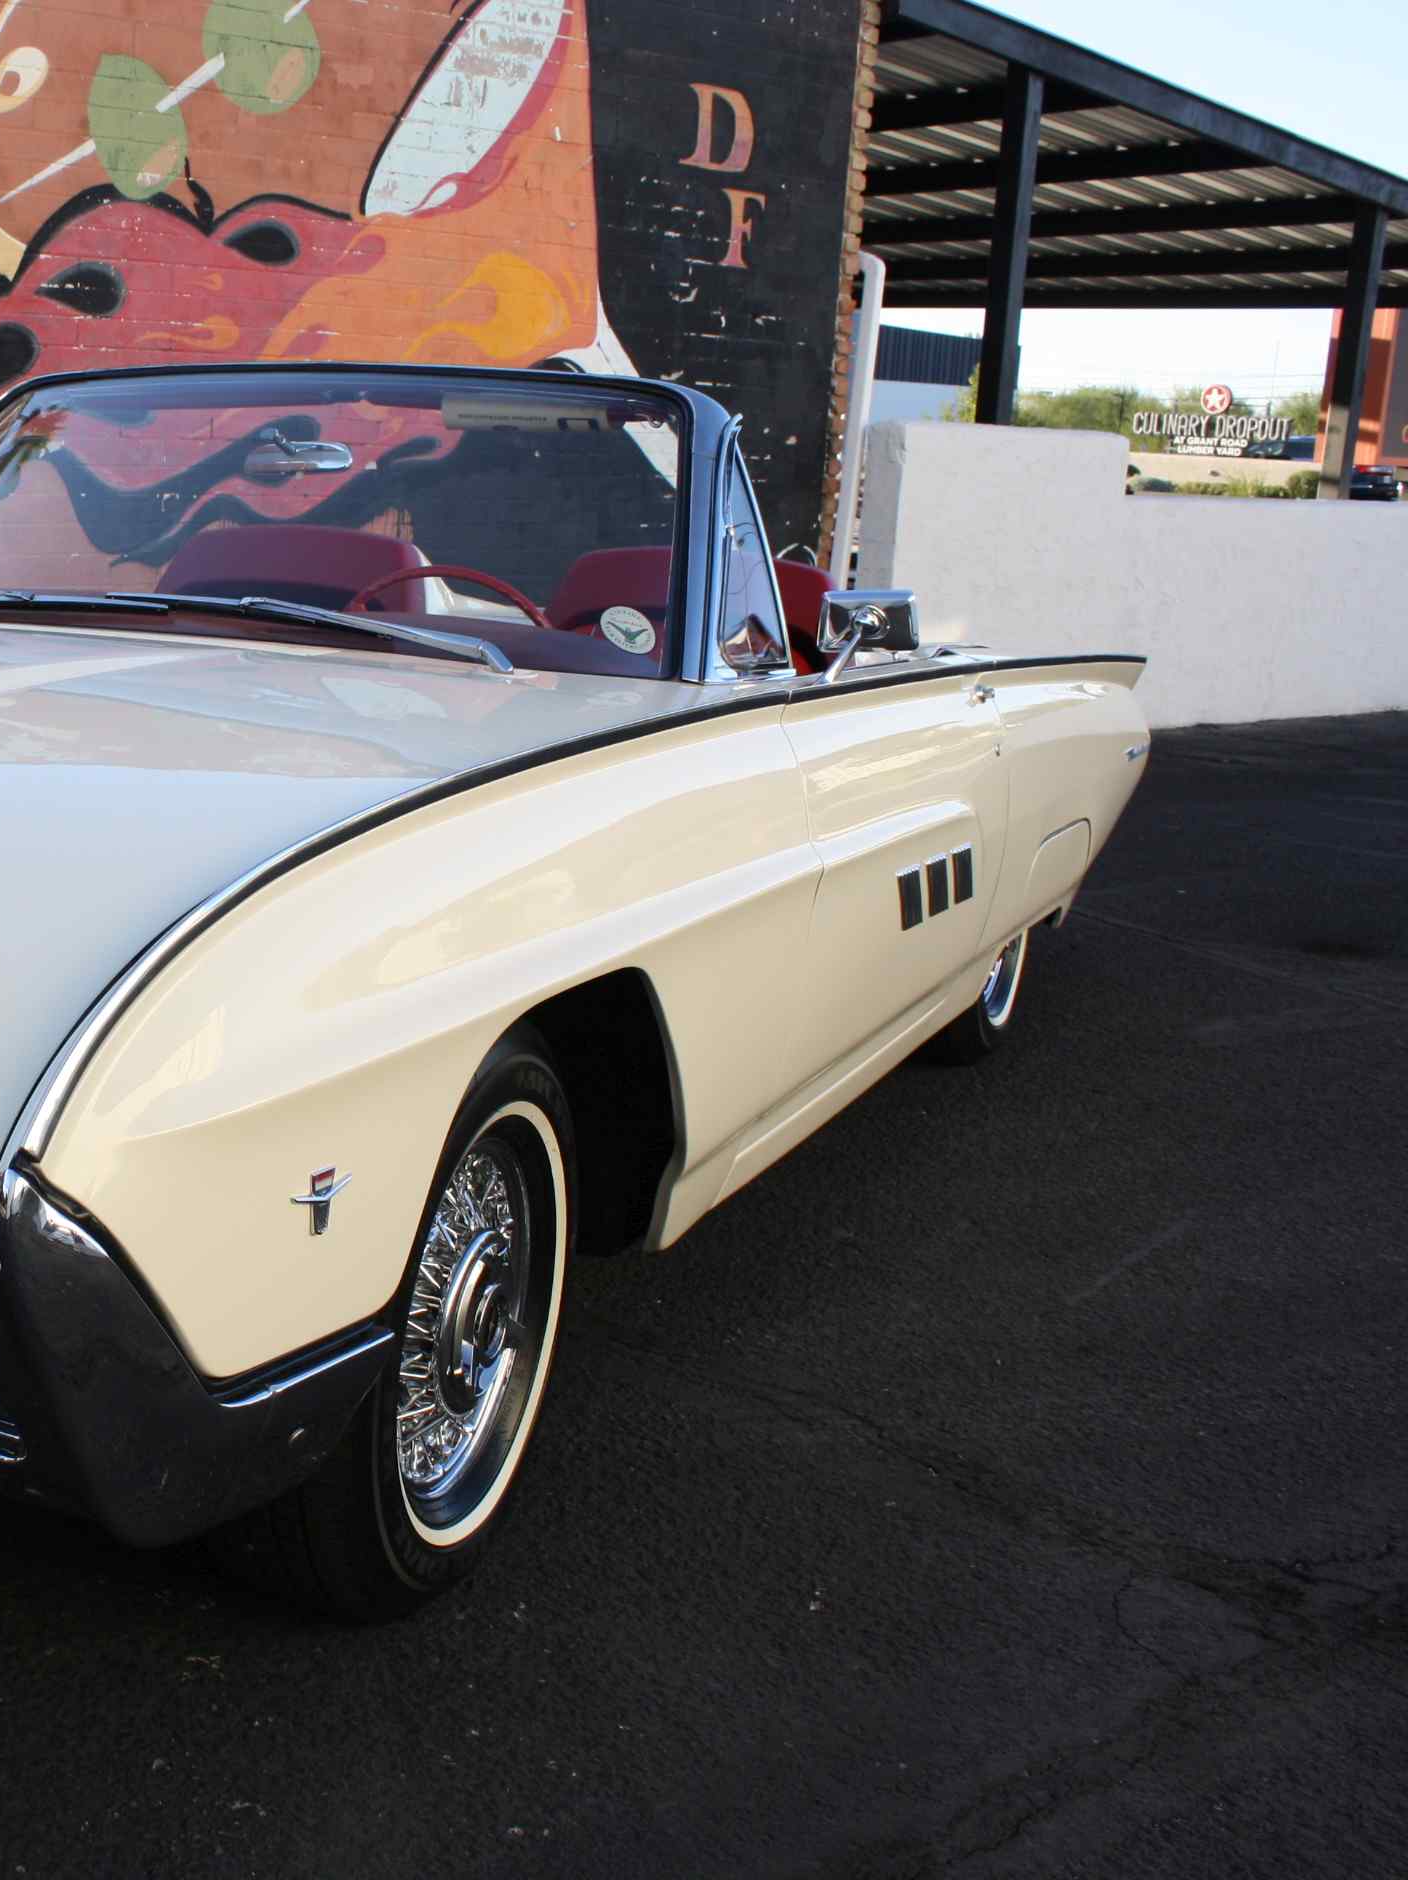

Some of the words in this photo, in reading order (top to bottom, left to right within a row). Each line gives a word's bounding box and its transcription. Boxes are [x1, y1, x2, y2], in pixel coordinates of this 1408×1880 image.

[678, 82, 756, 173] D
[718, 187, 767, 269] F
[1133, 412, 1209, 437] CULINARY
[1215, 416, 1291, 441] DROPOUT
[1173, 437, 1186, 445] AT
[1187, 438, 1219, 446] GRANT
[1220, 439, 1248, 448] ROAD
[1178, 446, 1214, 455] LUMBER
[1216, 447, 1242, 457] YARD
